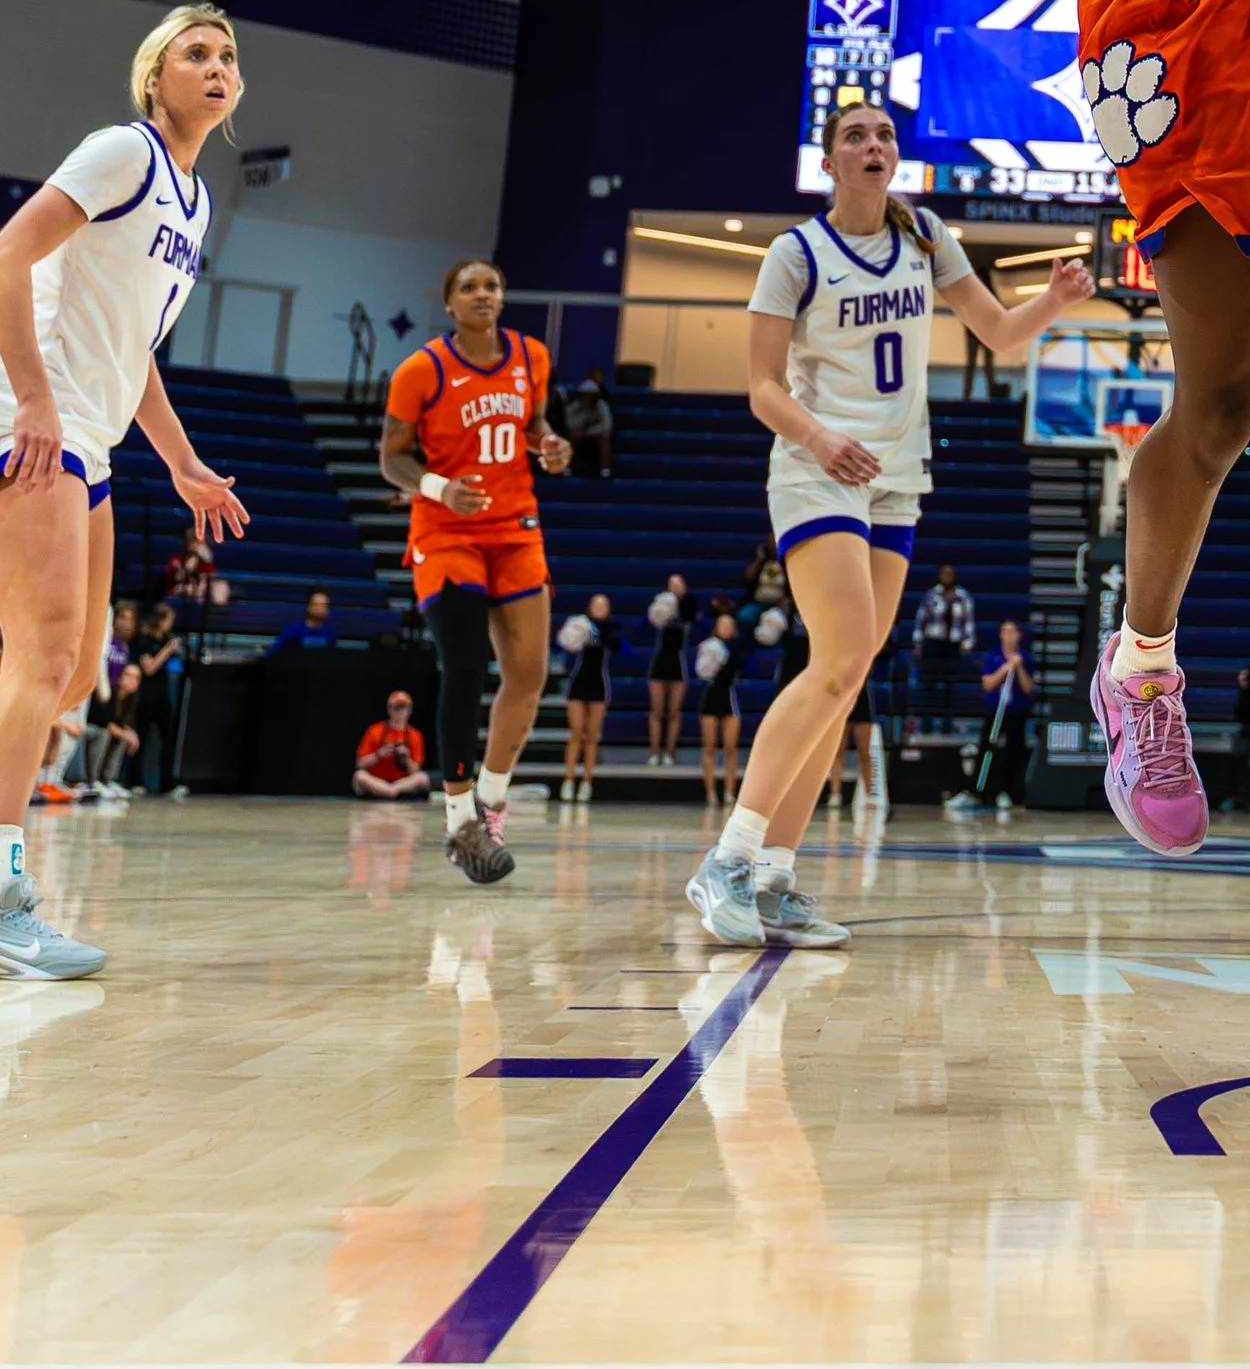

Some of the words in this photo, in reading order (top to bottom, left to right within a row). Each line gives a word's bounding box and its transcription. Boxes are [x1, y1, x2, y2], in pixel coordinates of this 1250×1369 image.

[989, 168, 1026, 194] 33
[148, 224, 201, 279] FURMA
[838, 285, 926, 327] FURMAN
[874, 331, 903, 394] 0
[461, 392, 526, 428] CLEMSON
[478, 422, 516, 464] 10
